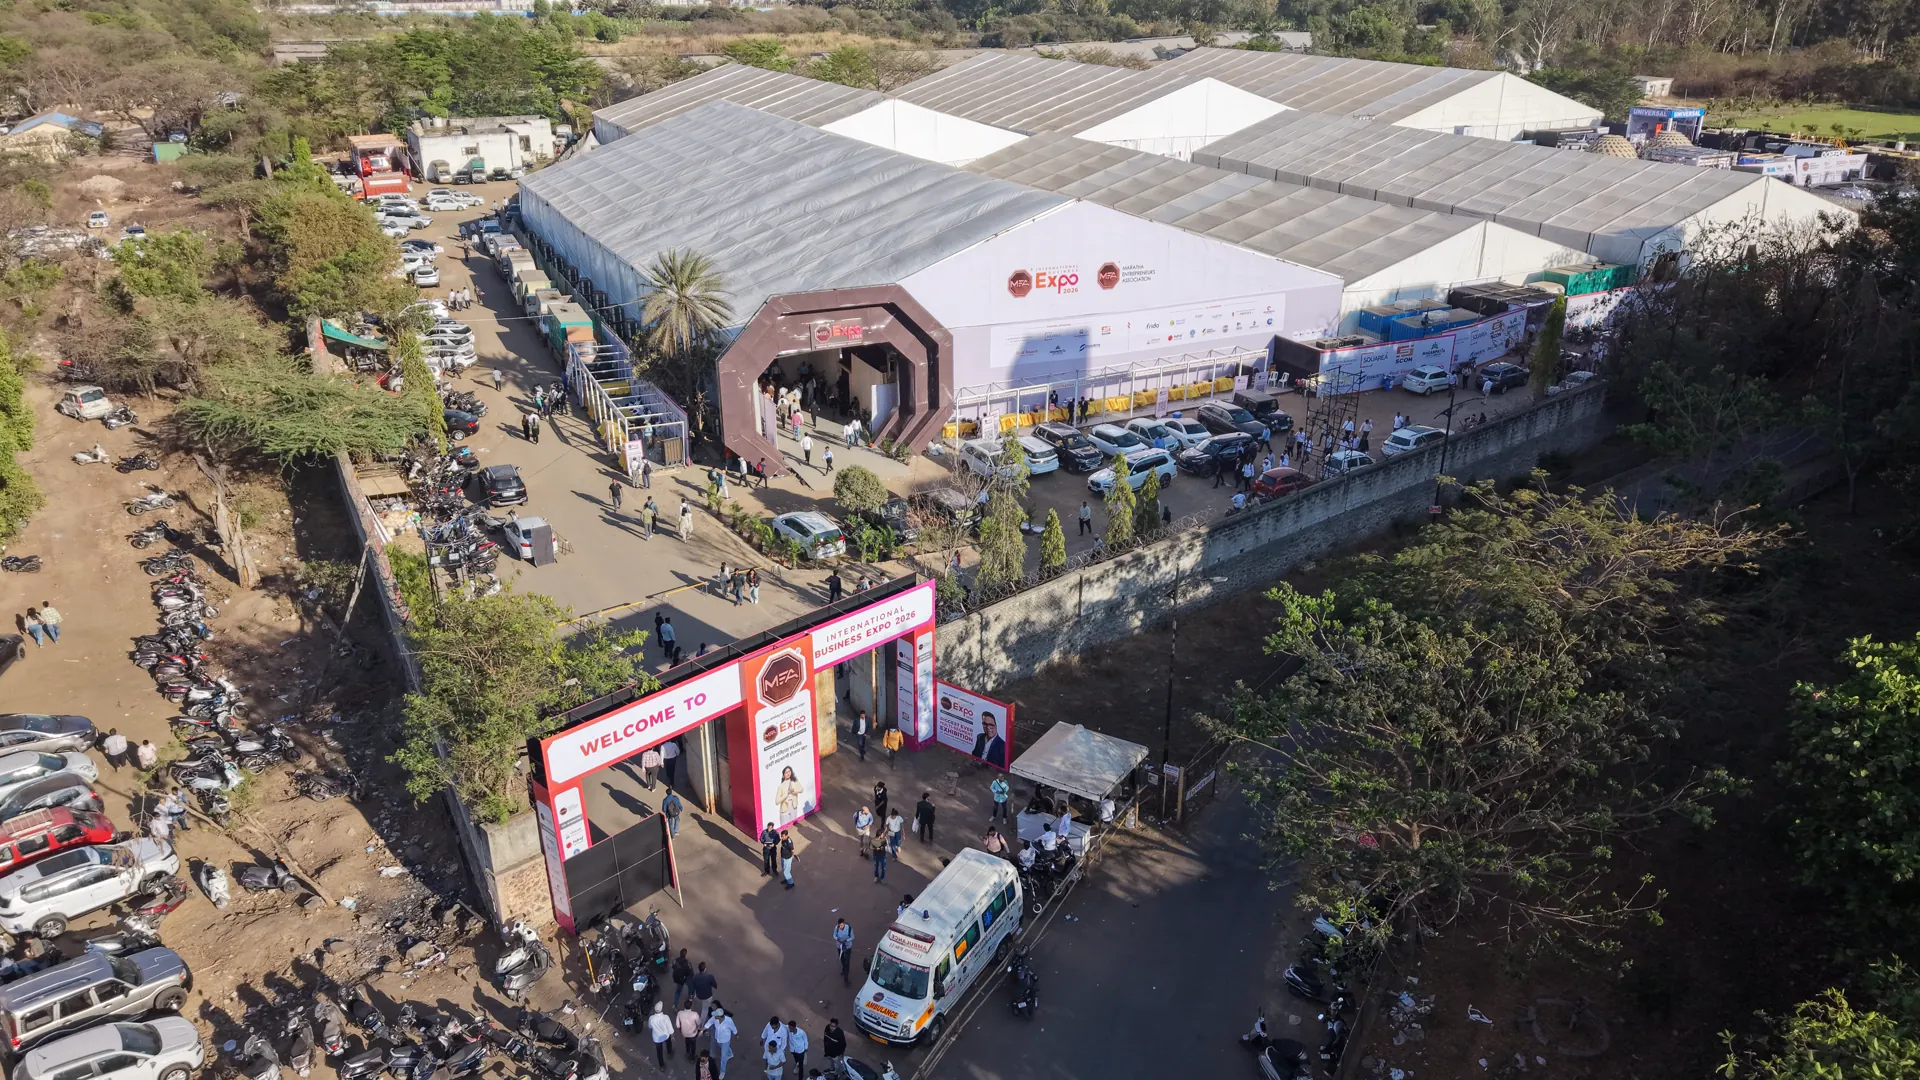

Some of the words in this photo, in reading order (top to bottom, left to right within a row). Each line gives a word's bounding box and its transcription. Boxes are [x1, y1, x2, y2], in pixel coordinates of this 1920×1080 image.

[1633, 109, 1667, 117] UNIVERSAL
[1122, 269, 1156, 277] ENTREPRENEURS
[1035, 272, 1079, 294] Expo
[832, 325, 863, 340] Expo
[1146, 322, 1160, 330] frido
[827, 605, 905, 642] INTERNATIONAL
[814, 633, 862, 659] BUSINESS
[866, 621, 891, 638] EXPO
[895, 610, 916, 625] 2026
[952, 701, 974, 717] Expo
[580, 705, 676, 757] WELCOME
[683, 693, 707, 711] TO
[780, 715, 806, 733] Expo
[940, 725, 974, 743] EXHIBITION
[865, 1000, 899, 1019] AMBULANCE
